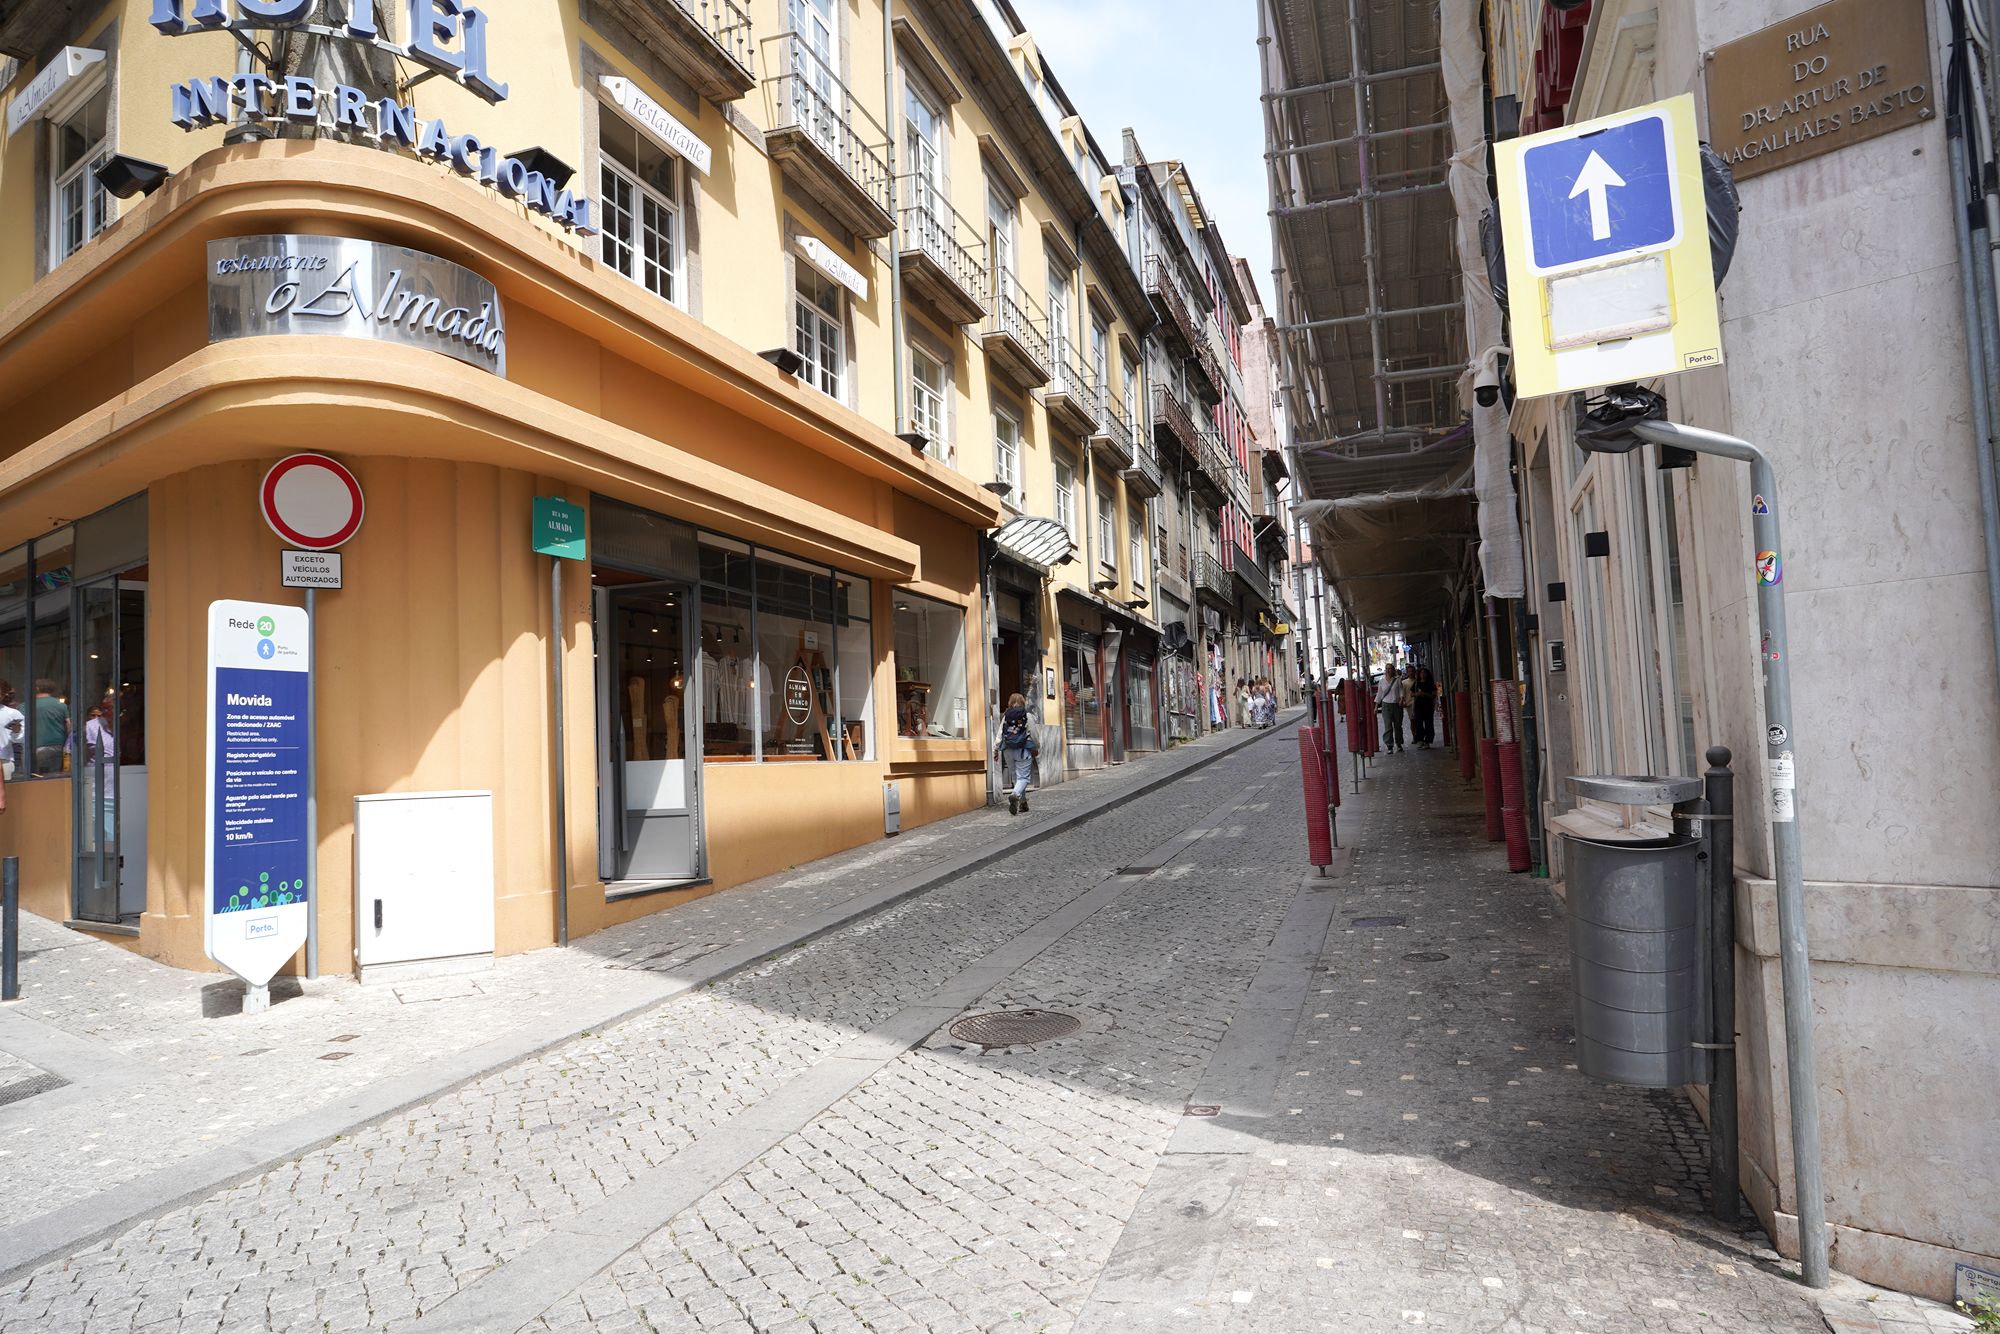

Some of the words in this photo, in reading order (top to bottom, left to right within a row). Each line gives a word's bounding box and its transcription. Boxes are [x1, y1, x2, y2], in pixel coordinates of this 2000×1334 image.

[1787, 24, 1830, 52] RUA
[1793, 55, 1828, 82] DO
[1779, 78, 1851, 118] ARTUR
[1858, 65, 1887, 90] DE
[1850, 85, 1926, 124] BASTO
[633, 95, 704, 163] restaurante
[170, 73, 598, 236] INTERNACIONAL
[215, 251, 328, 277] restaurante
[1689, 354, 1714, 364] Porto.
[548, 520, 572, 533] ALMADA
[292, 565, 330, 573] VEÍCULOS
[285, 576, 339, 584] AUTORIZADOS
[228, 618, 255, 629] Rede
[260, 621, 272, 631] 20
[227, 693, 272, 707] Movida
[250, 924, 274, 933] Porto.
